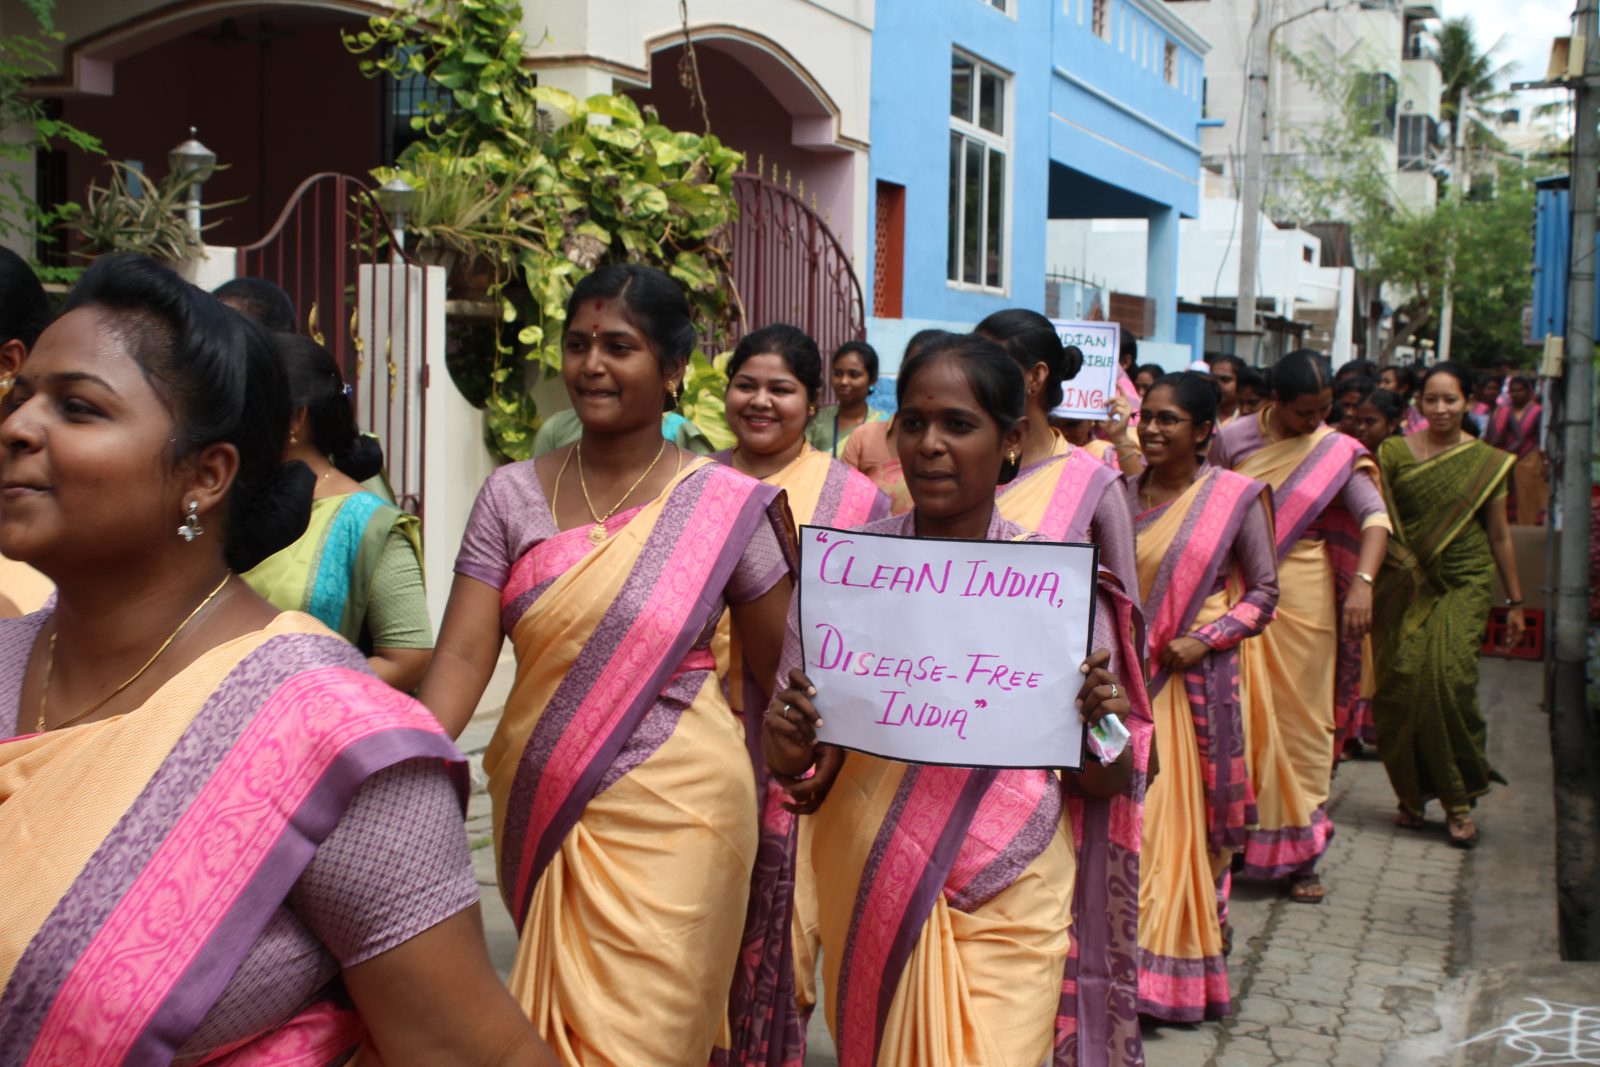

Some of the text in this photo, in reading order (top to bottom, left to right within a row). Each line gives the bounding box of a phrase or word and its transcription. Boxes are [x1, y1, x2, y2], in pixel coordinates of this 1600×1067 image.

[1059, 333, 1107, 349] DIAN
[1062, 387, 1105, 409] ING
[959, 559, 1065, 609] INDIA,
